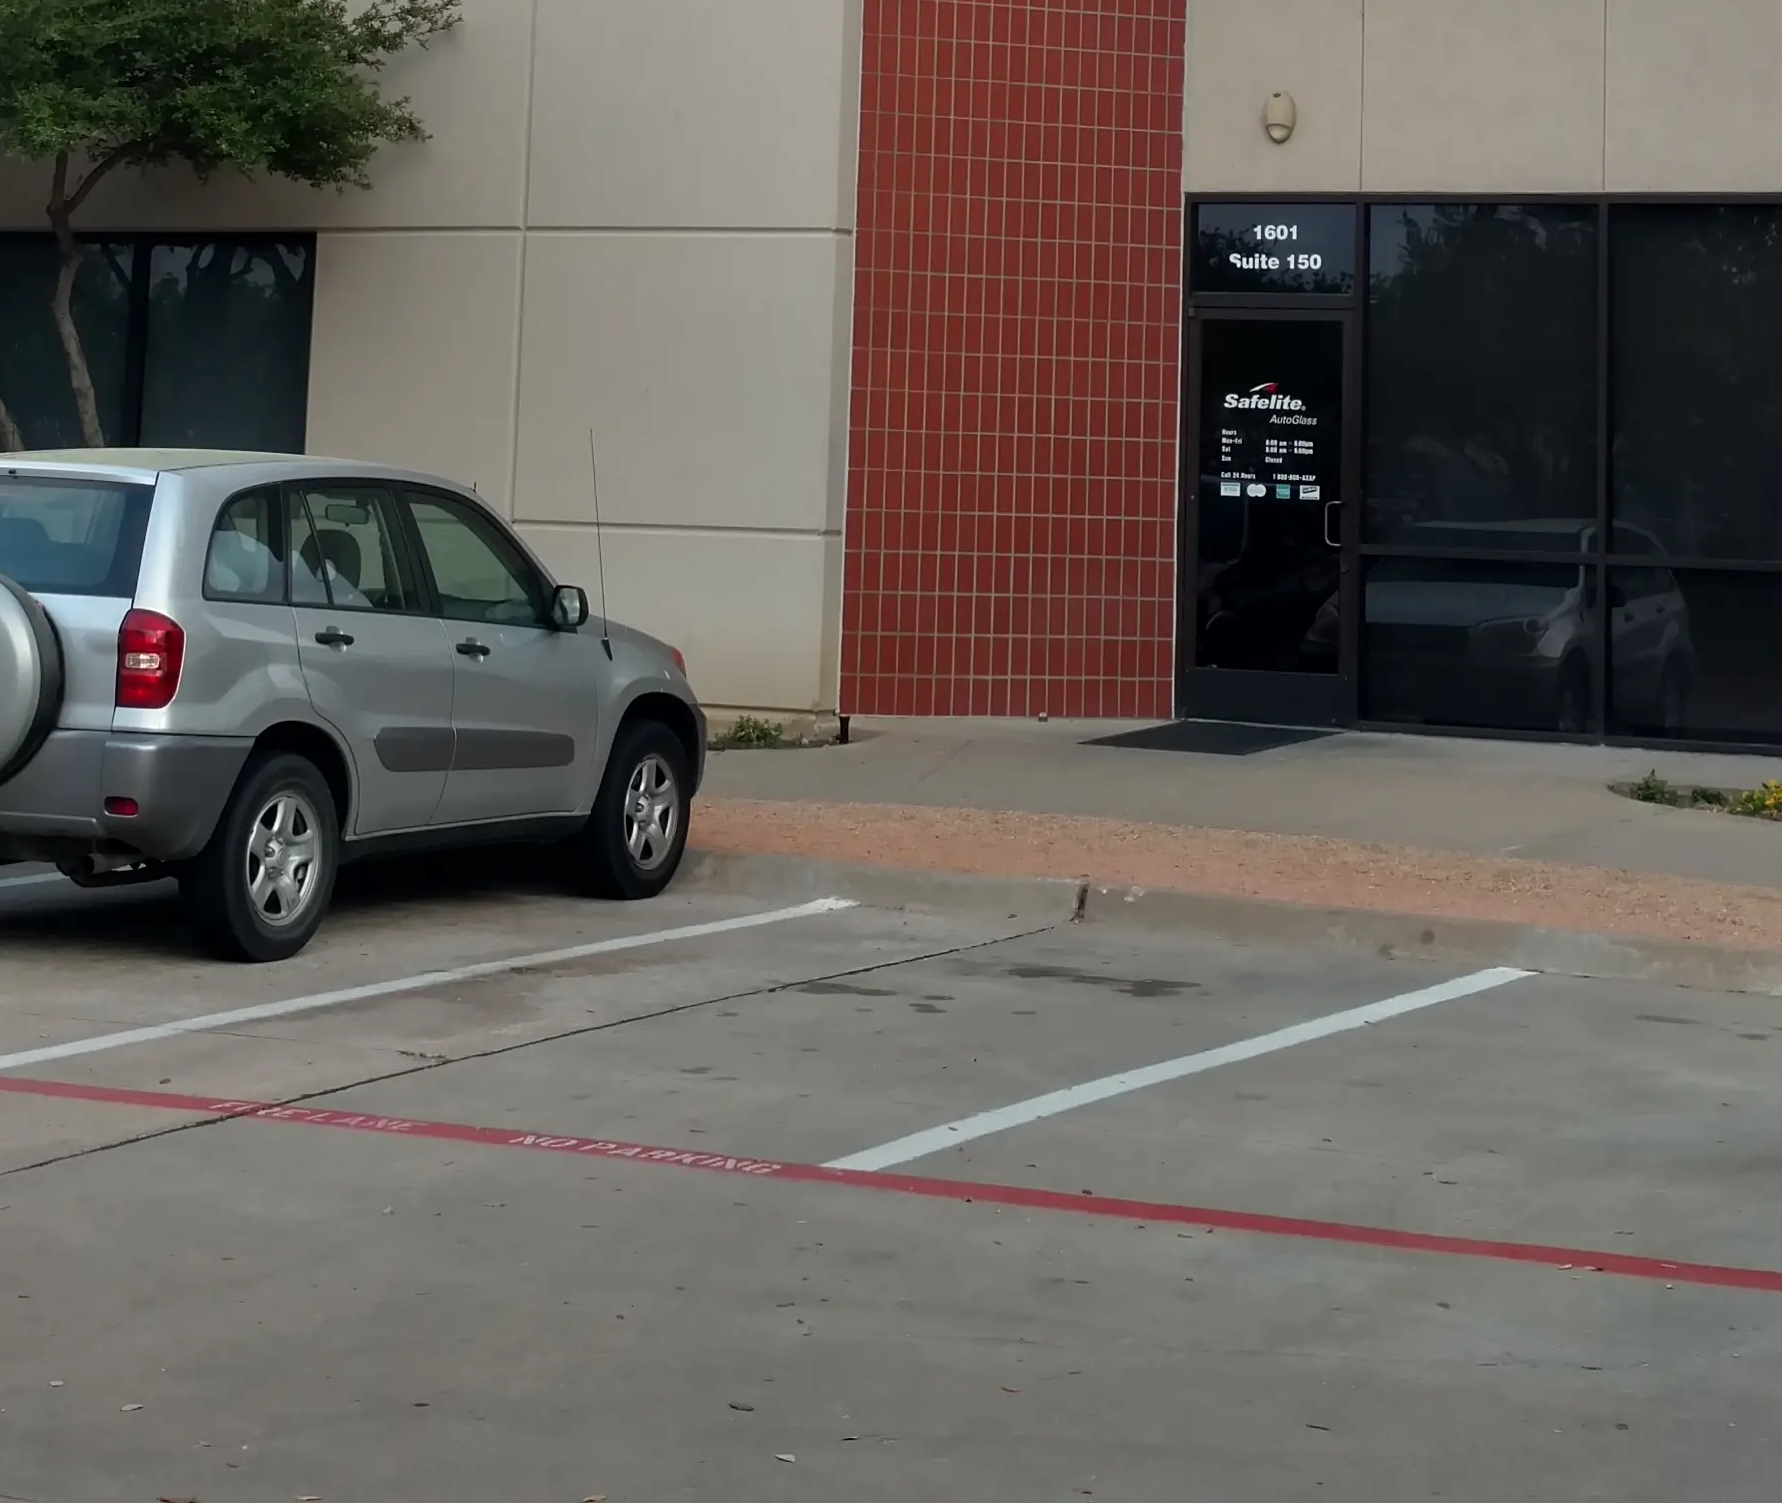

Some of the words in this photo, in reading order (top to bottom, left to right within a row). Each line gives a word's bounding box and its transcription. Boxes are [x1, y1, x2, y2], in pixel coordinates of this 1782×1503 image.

[1253, 224, 1298, 240] 1601
[1229, 253, 1280, 270] Suite
[1286, 254, 1322, 270] 150
[1269, 414, 1318, 425] AutoGlass
[1221, 428, 1238, 436] Hours
[303, 1111, 431, 1131] LANE
[507, 1134, 579, 1148] NO
[577, 1141, 782, 1174] PARKING
